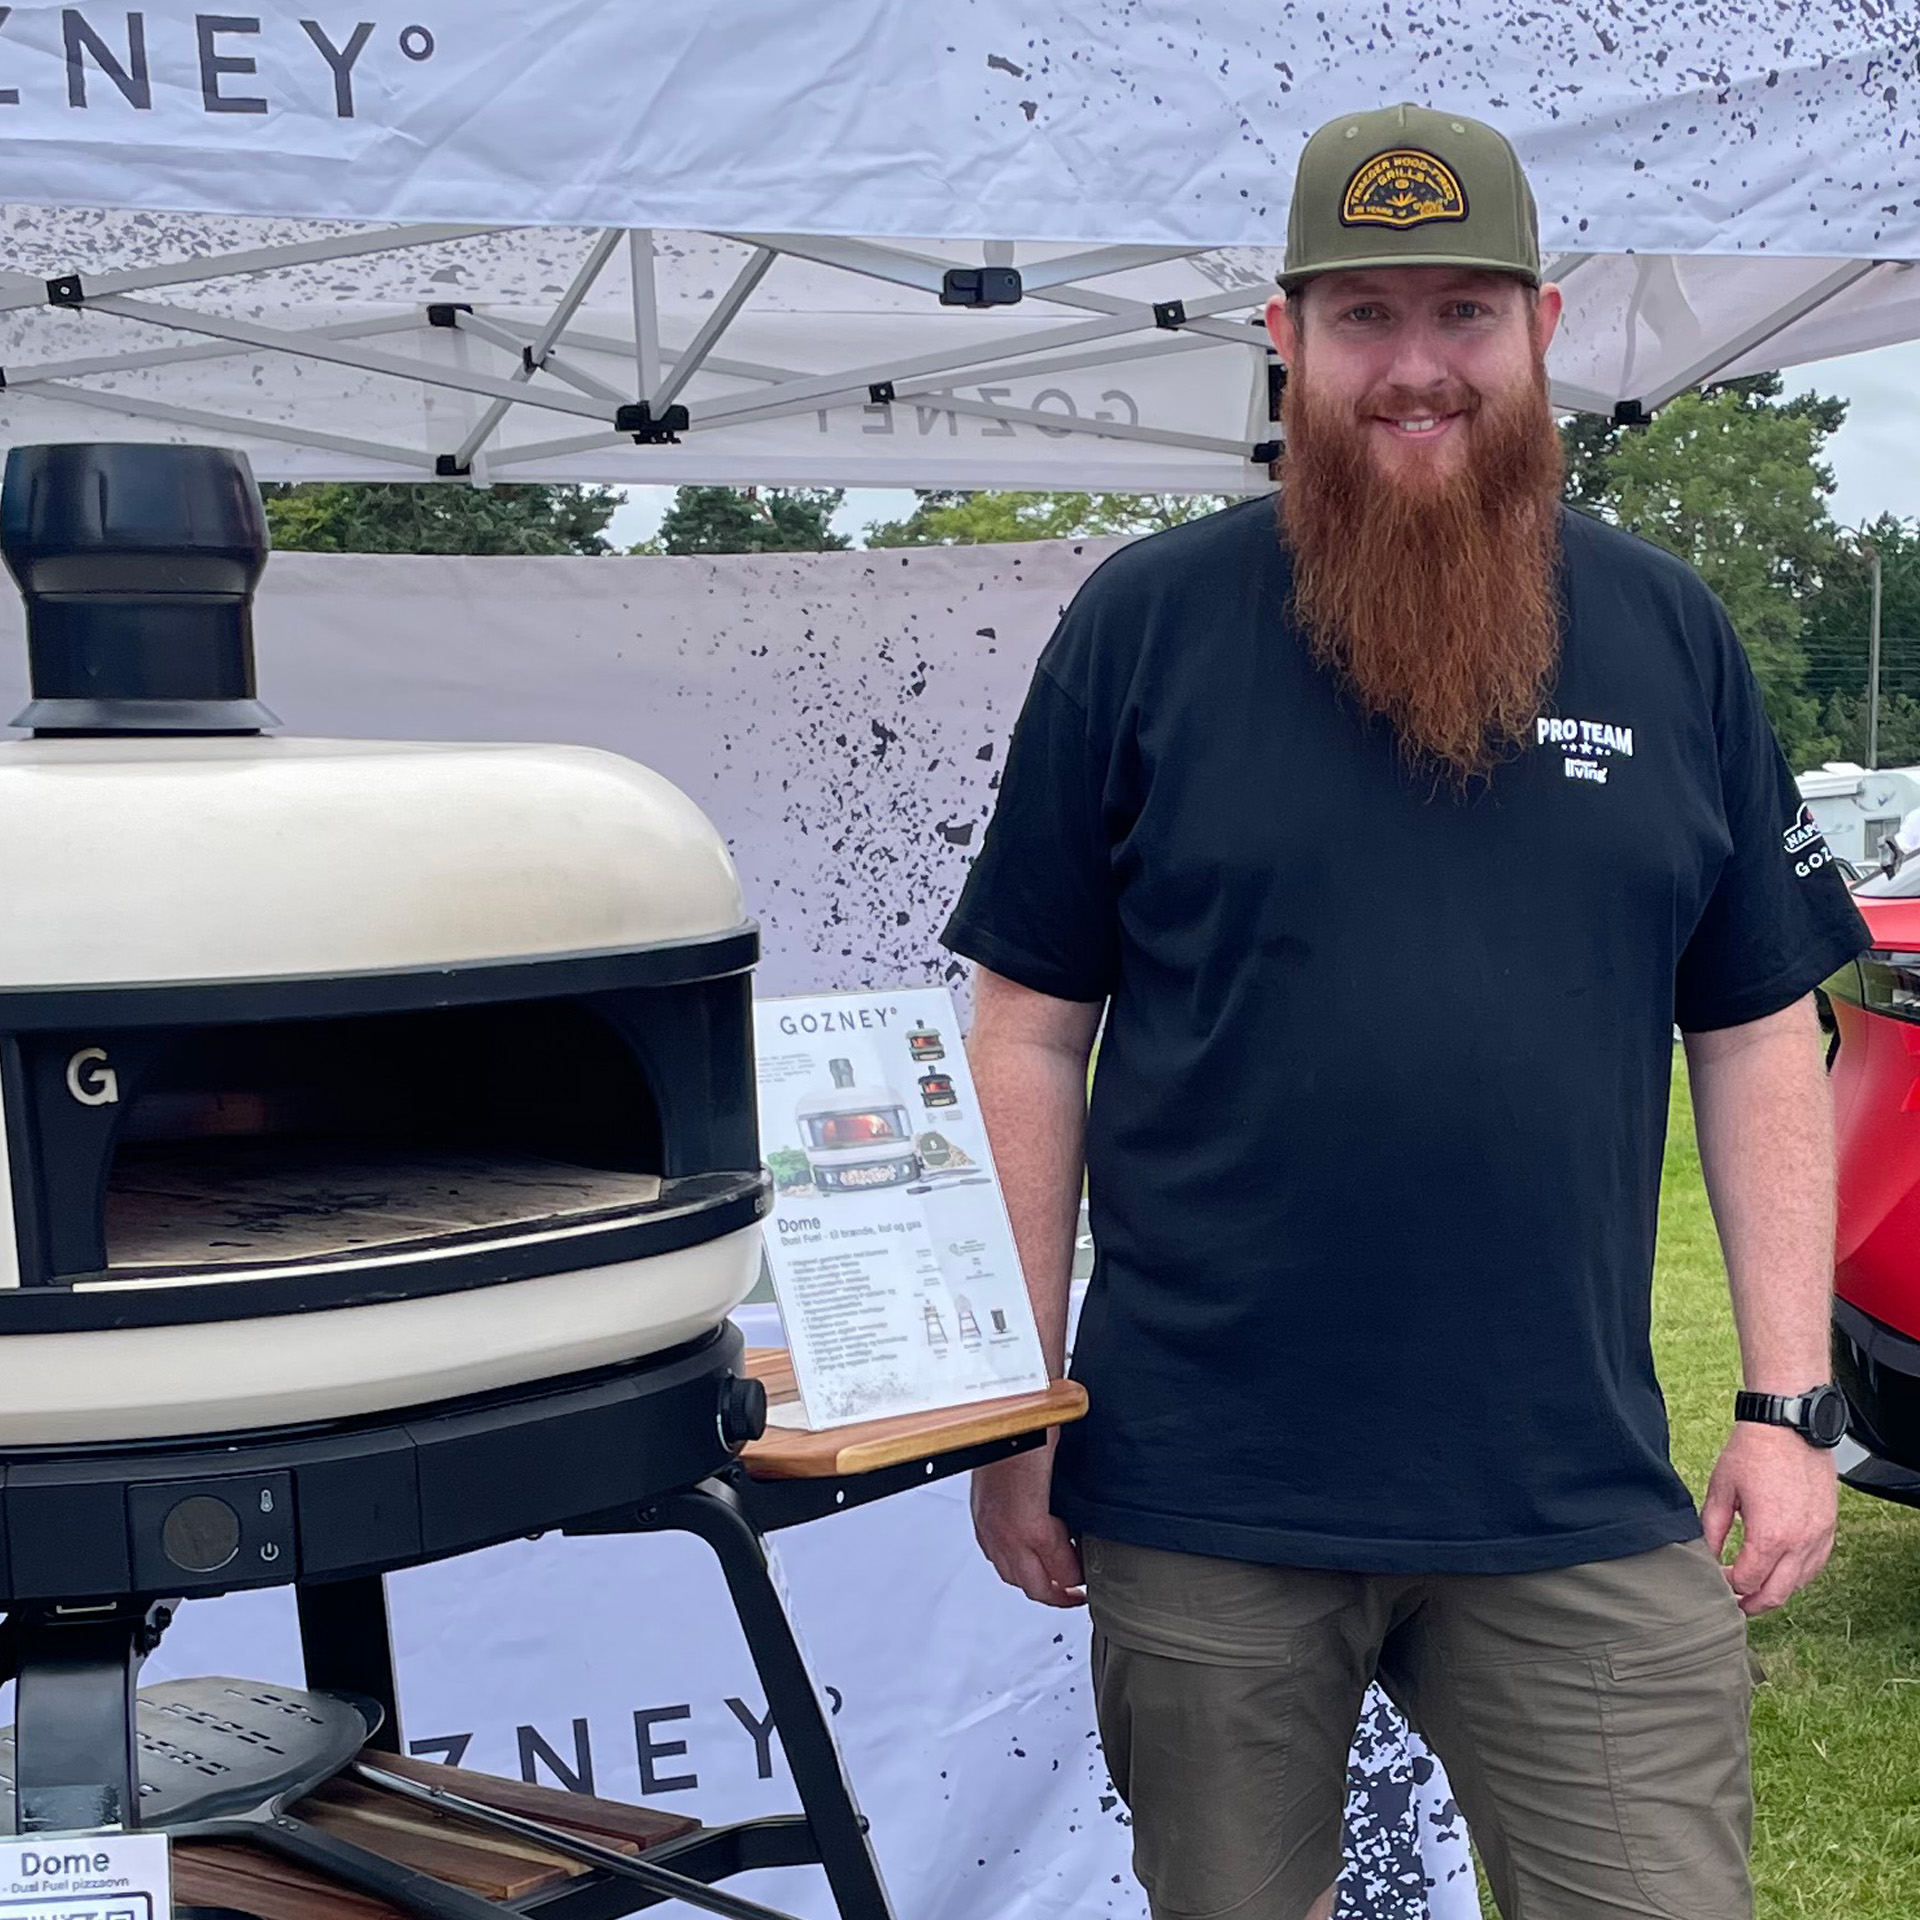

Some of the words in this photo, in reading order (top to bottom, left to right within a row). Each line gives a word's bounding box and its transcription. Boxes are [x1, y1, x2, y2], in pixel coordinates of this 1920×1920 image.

[1537, 717, 1577, 745] PRO
[1579, 721, 1633, 757] TEAM
[66, 1047, 119, 1106] G
[777, 1217, 821, 1234] Dome
[22, 1852, 110, 1877] Dome
[11, 1882, 39, 1894] Dual
[42, 1879, 69, 1892] Fuel
